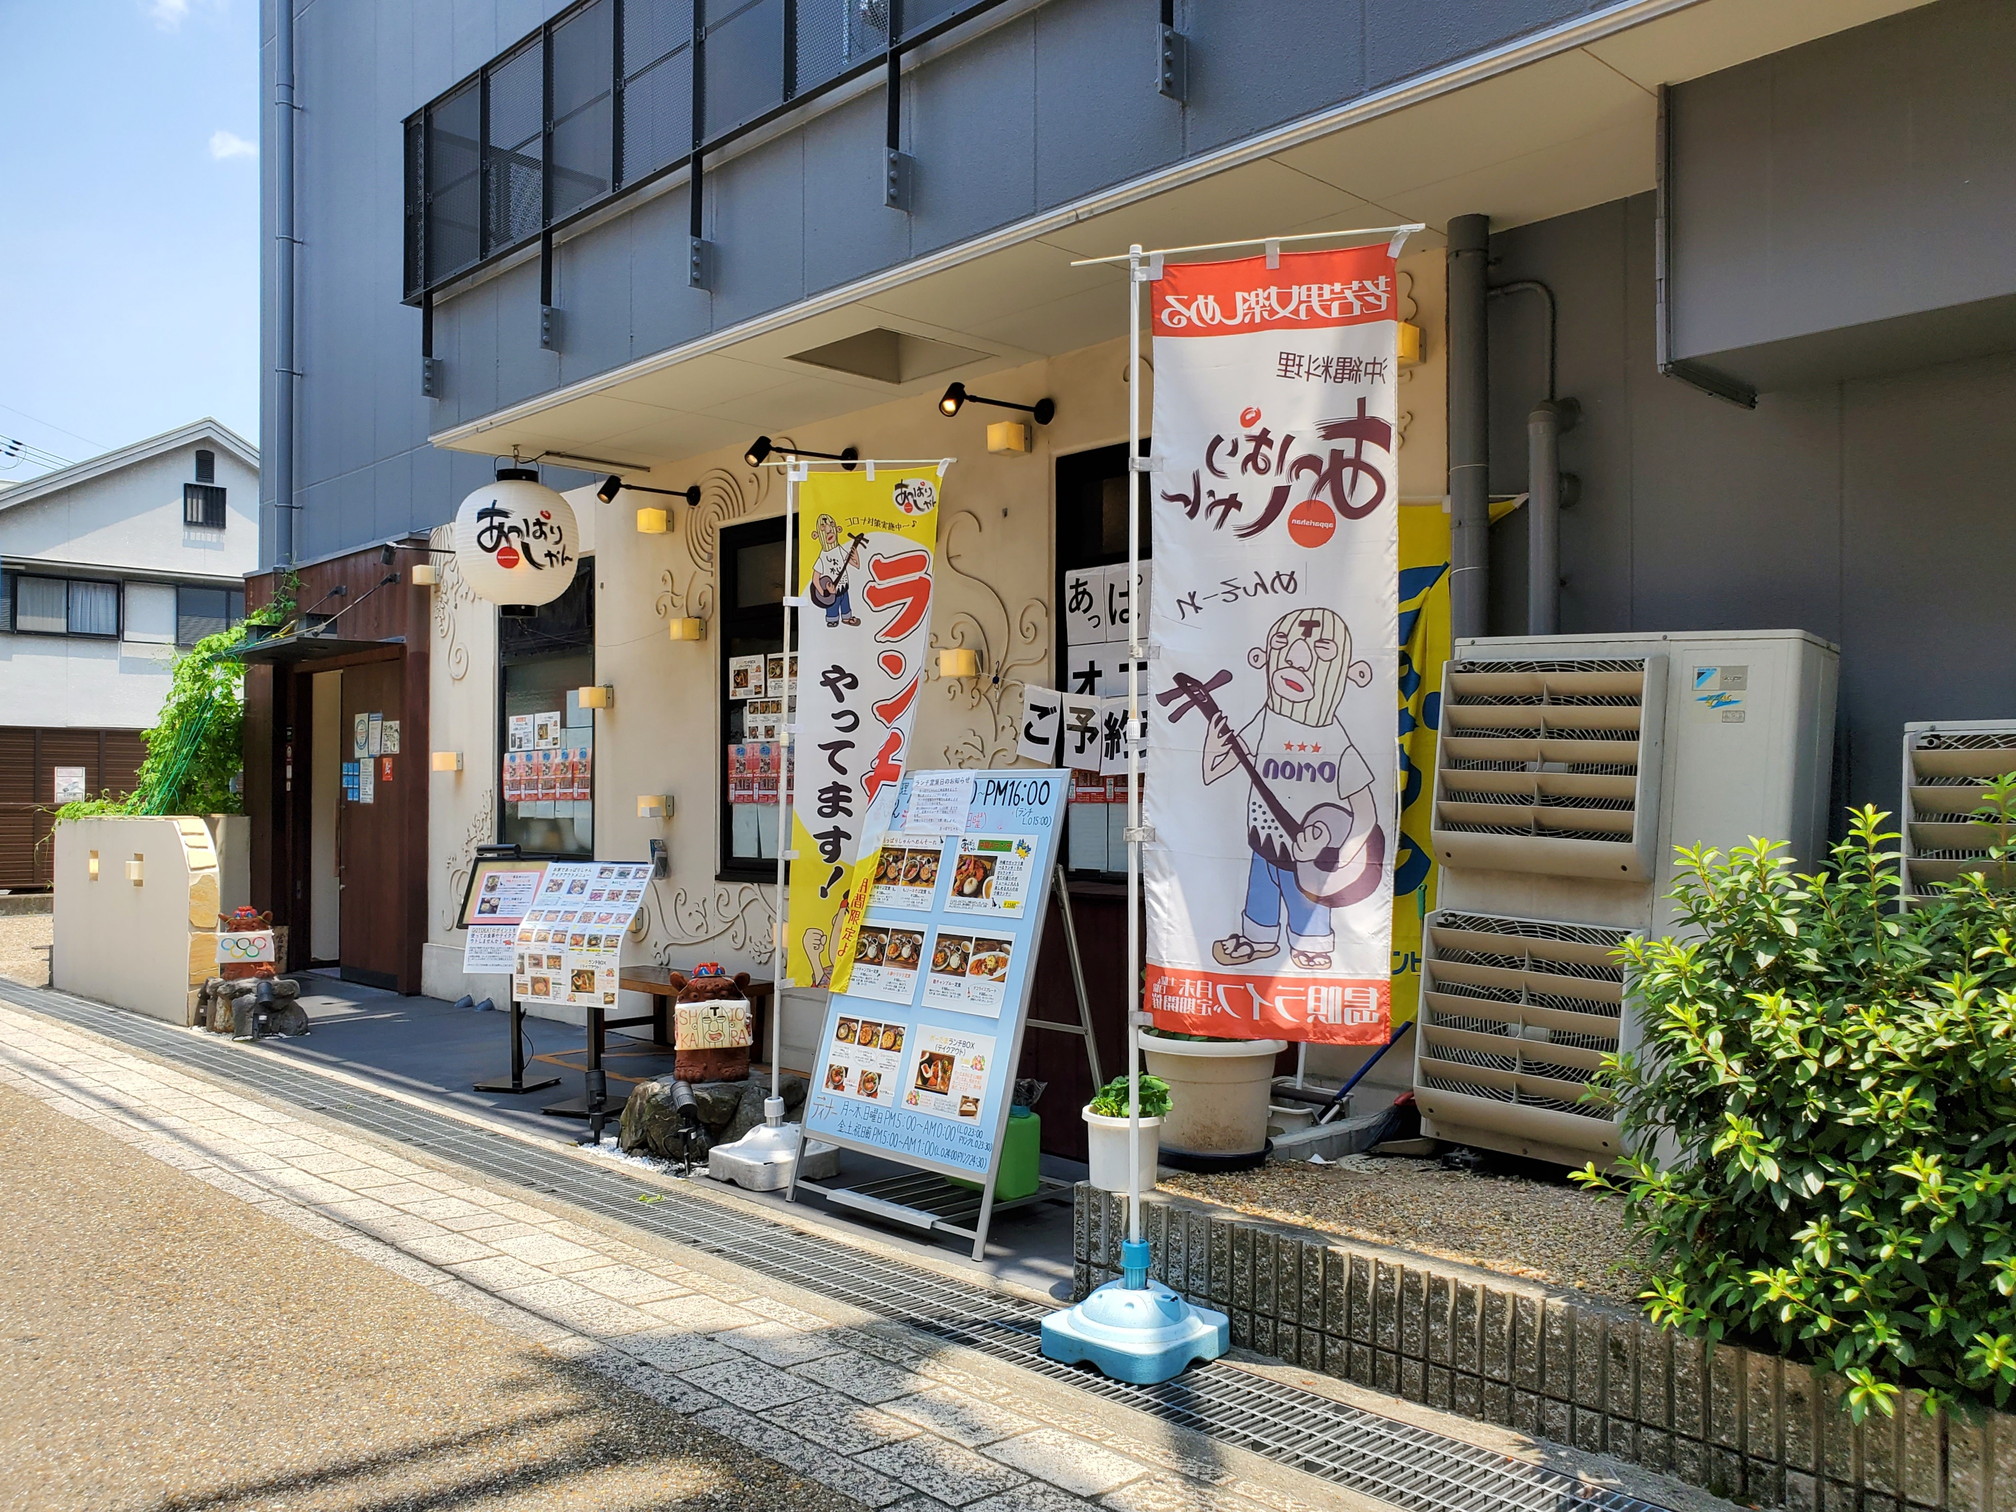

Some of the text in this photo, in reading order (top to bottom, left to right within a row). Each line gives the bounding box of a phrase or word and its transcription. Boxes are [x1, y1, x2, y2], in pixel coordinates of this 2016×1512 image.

[476, 499, 573, 571] あっぱりしゃん
